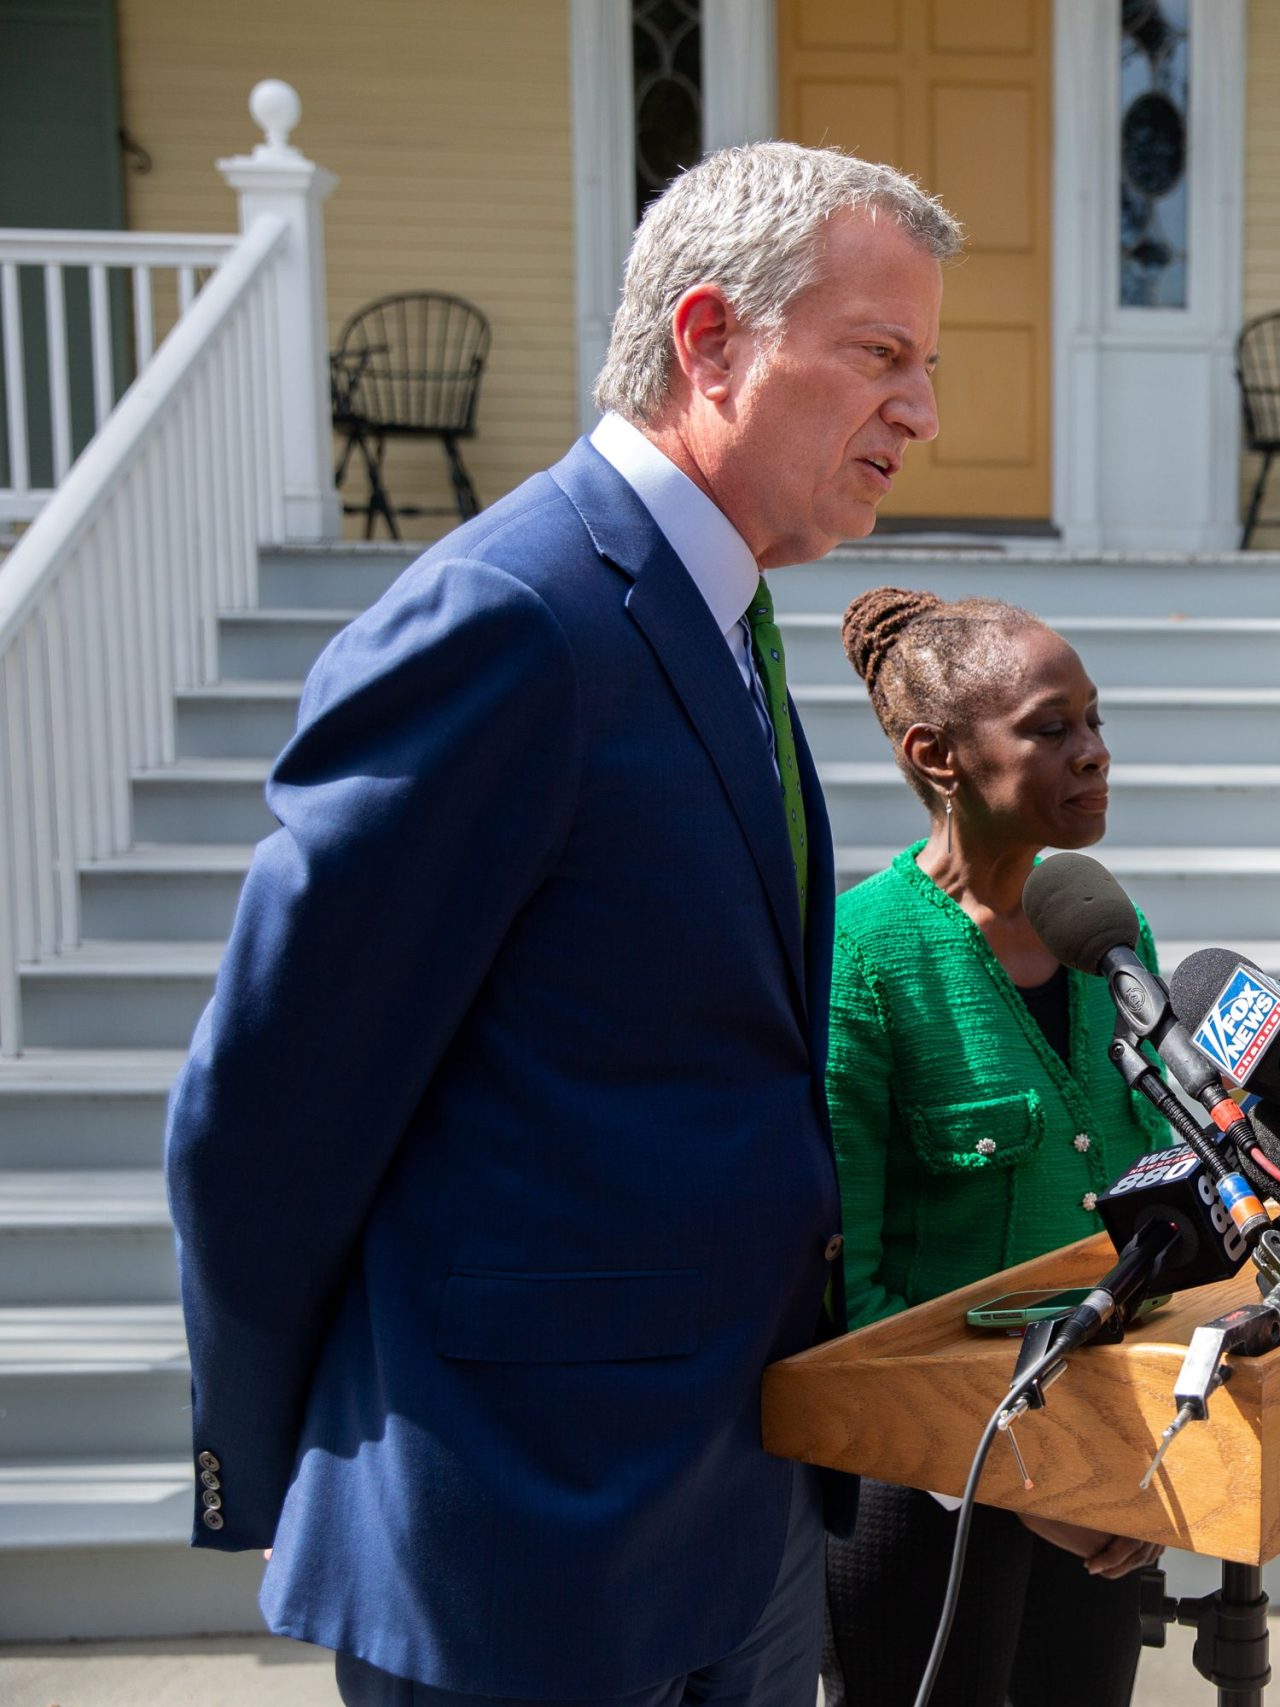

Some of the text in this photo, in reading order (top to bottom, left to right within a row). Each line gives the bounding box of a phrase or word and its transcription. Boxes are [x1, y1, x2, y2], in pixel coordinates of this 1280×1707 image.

[1221, 982, 1264, 1036] FOX
[1227, 993, 1273, 1060] NEWS
[1109, 1158, 1197, 1195] 880
